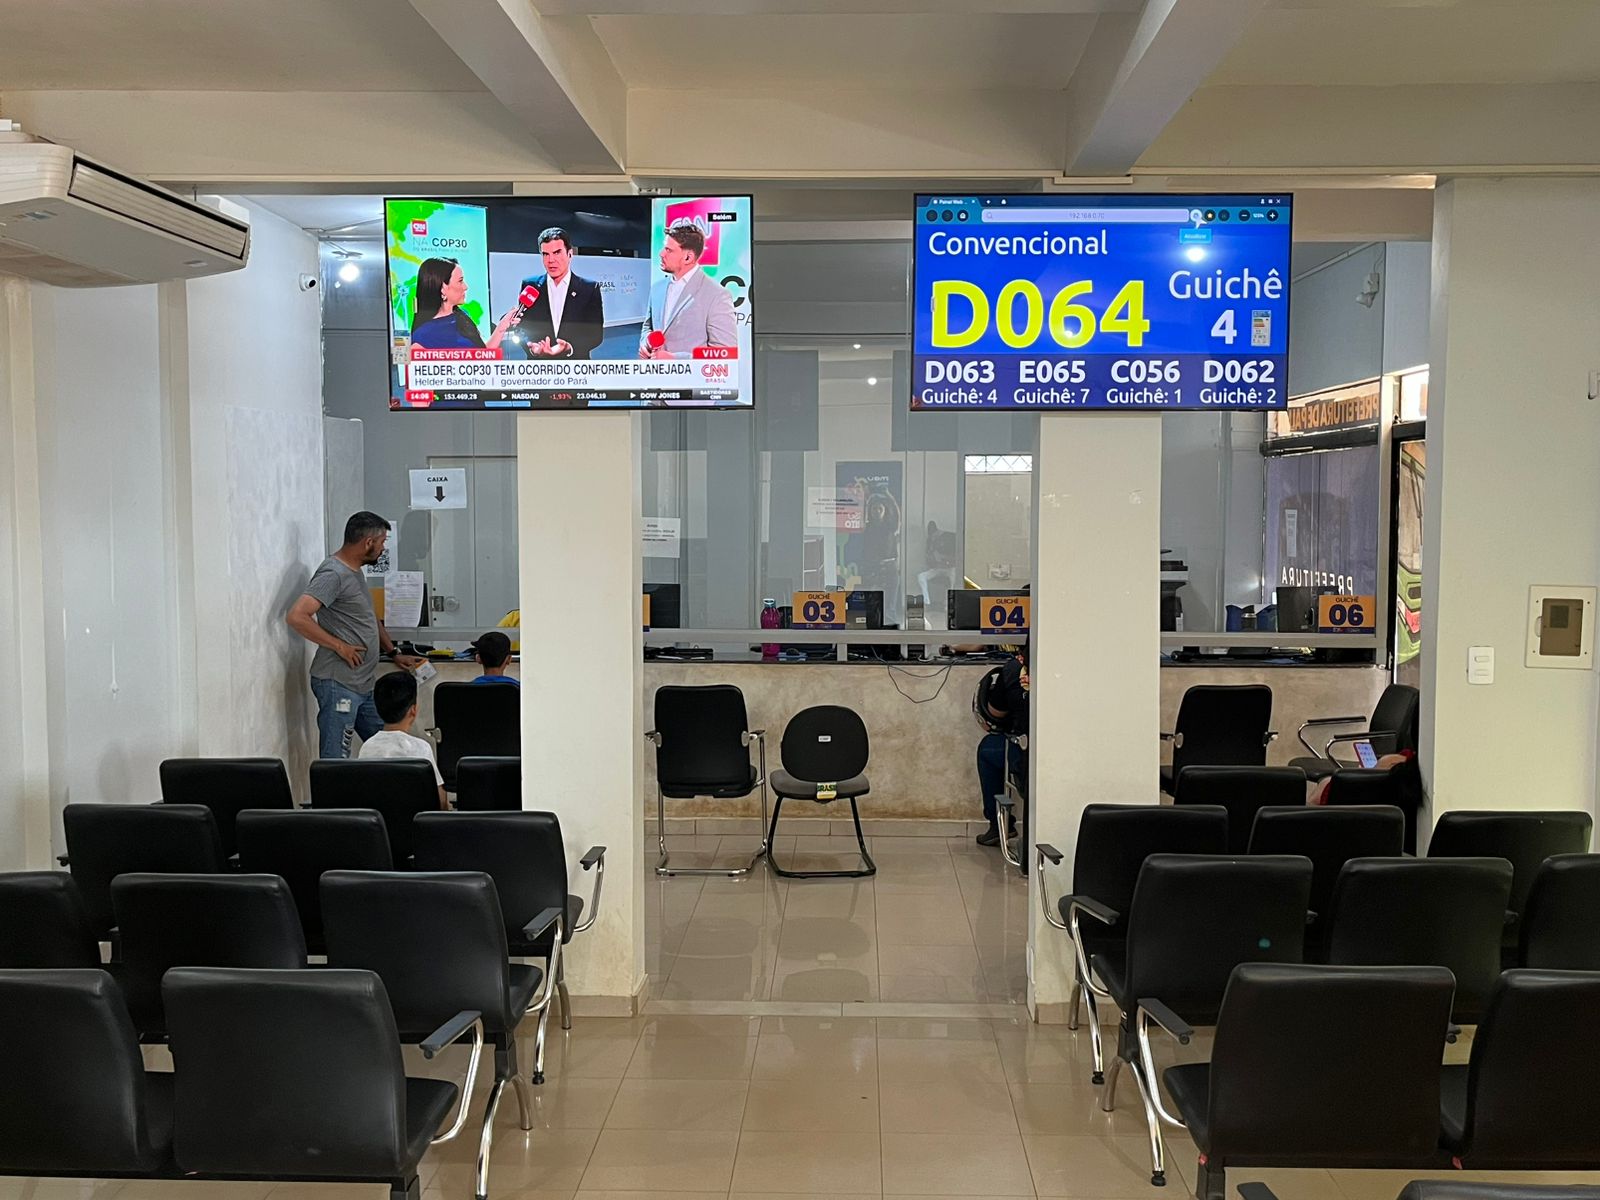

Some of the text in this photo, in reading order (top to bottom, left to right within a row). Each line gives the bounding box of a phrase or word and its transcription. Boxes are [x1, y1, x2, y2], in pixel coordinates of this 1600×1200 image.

[431, 237, 468, 248] COP30
[928, 229, 1108, 256] Convencional
[1168, 267, 1283, 300] Guichê
[931, 278, 1151, 349] D064
[1210, 309, 1238, 345] 4
[413, 350, 496, 360] ENTREVISTA CNN
[702, 349, 729, 358] VIVO
[414, 363, 692, 376] HELDER: COP30 TEM OCORRIDO CONFORME PLANEJADA
[700, 363, 729, 378] CNN
[925, 359, 995, 384] D063
[1019, 359, 1086, 384] E065
[1110, 359, 1181, 384] C056
[1203, 359, 1275, 384] D062
[414, 376, 588, 388] Helder Barbalho governador do Pará
[921, 388, 998, 404] Guichê: 4
[1013, 388, 1090, 404] Guichê: 7
[1106, 387, 1182, 404] Guichê: 1
[1199, 387, 1277, 404] Guichê: 2
[803, 600, 835, 622] 03
[989, 605, 1025, 627] 04
[1329, 604, 1364, 626] 06
